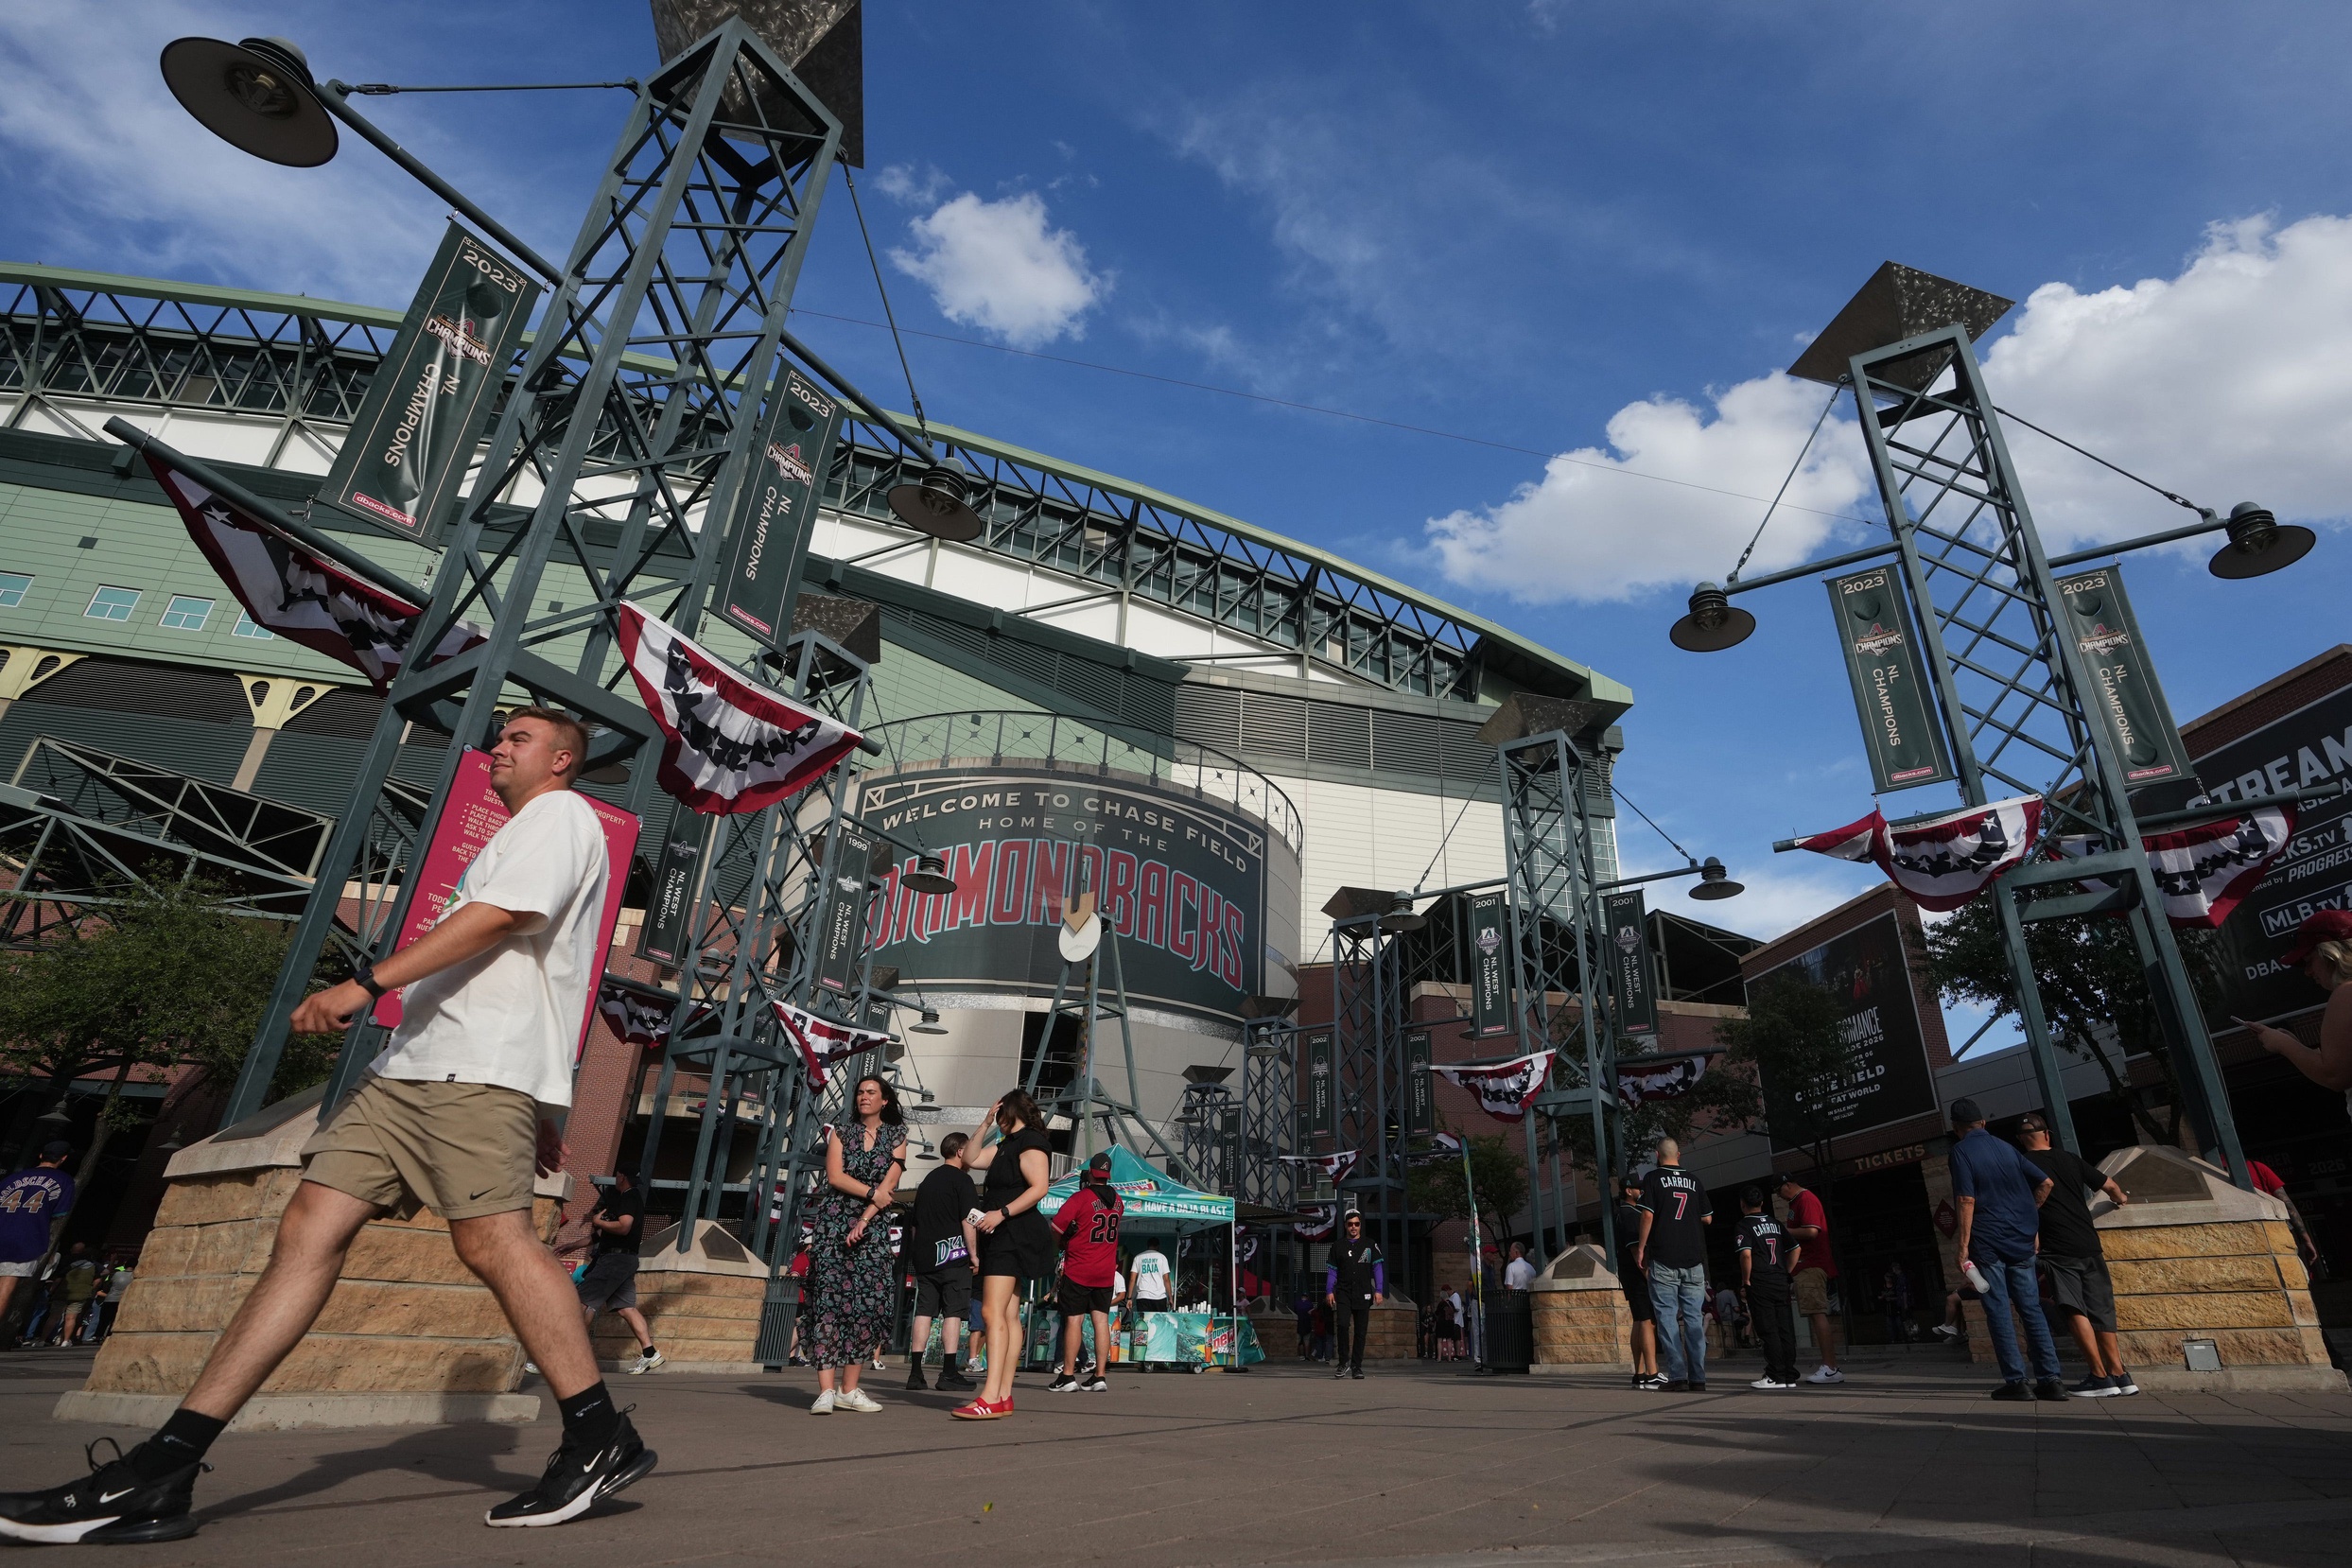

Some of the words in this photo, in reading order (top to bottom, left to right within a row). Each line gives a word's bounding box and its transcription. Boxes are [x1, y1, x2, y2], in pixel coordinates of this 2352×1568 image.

[463, 250, 517, 293] 2023
[427, 319, 491, 366] CHAMPIONS
[440, 374, 461, 396] NL
[790, 381, 830, 418] 2023
[384, 363, 441, 467] CHAMPIONS
[768, 445, 812, 486] CHAMPIONS
[357, 495, 413, 524] dbacks.com
[777, 495, 792, 515] NL
[745, 485, 777, 581] CHAMPIONS
[1843, 576, 1885, 595] 2023
[2063, 577, 2106, 595] 2023
[732, 606, 770, 633] dbacks.com
[1855, 634, 1903, 653] CHAMPIONS
[2080, 634, 2129, 653] CHAMPIONS
[1887, 664, 1900, 685] NL
[2114, 664, 2128, 684] NL
[1872, 668, 1901, 747] CHAMPIONS
[2099, 667, 2134, 746] CHAMPIONS
[479, 762, 492, 773] ALL
[1893, 768, 1931, 781] dbacks.com
[2130, 766, 2170, 779] dbacks.com
[483, 795, 504, 807] GUESTS
[468, 816, 483, 827] WALK
[470, 810, 486, 821] PLACE
[488, 816, 502, 826] BAGS
[472, 804, 489, 814] PLACE
[490, 810, 512, 823] PHONES
[594, 809, 626, 827] PROPERTY
[463, 828, 479, 839] WALK
[465, 823, 477, 831] ASK
[882, 792, 1021, 830] WELCOME
[1035, 791, 1070, 809] TO
[1084, 796, 1175, 833] CHASE
[1185, 826, 1247, 873] FIELD
[979, 816, 1056, 829] HOME
[1073, 822, 1106, 834] OF
[1122, 828, 1168, 851] THE
[452, 845, 467, 856] BACK
[848, 837, 867, 851] 1999
[458, 855, 468, 863] THE
[2288, 845, 2352, 882] PROGRESS
[676, 870, 686, 885] NL
[2274, 876, 2284, 885] by
[657, 867, 677, 930] CHAMPIONS
[670, 887, 682, 916] WEST
[1475, 898, 1496, 909] 2001
[1612, 897, 1633, 907] 2001
[844, 904, 852, 919] NL
[862, 838, 1245, 993] DIAMONDBACKS
[830, 901, 845, 960] CHAMPIONS
[840, 920, 850, 948] WEST
[1491, 956, 1497, 969] NL
[1631, 955, 1638, 967] NL
[1483, 958, 1492, 1010] CHAMPIONS
[1623, 957, 1634, 1009] CHAMPIONS
[1633, 968, 1642, 993] WEST
[871, 1006, 885, 1016] 2001
[1863, 1034, 1885, 1048] 2026
[1320, 1079, 1325, 1089] NL
[1420, 1078, 1424, 1087] NL
[1848, 1084, 1881, 1099] WORLD
[1855, 1143, 1925, 1171] TICKETS
[1660, 1176, 1697, 1192] CARROLL
[0, 1190, 46, 1213] 44
[1040, 1197, 1063, 1209] HAVE
[1144, 1201, 1169, 1212] HAVE
[1170, 1203, 1176, 1212] A
[1673, 1192, 1688, 1220] 7
[1089, 1212, 1120, 1244] 28
[1752, 1223, 1781, 1237] CARROLL
[1765, 1238, 1776, 1265] 7
[1141, 1263, 1159, 1274] BAJA
